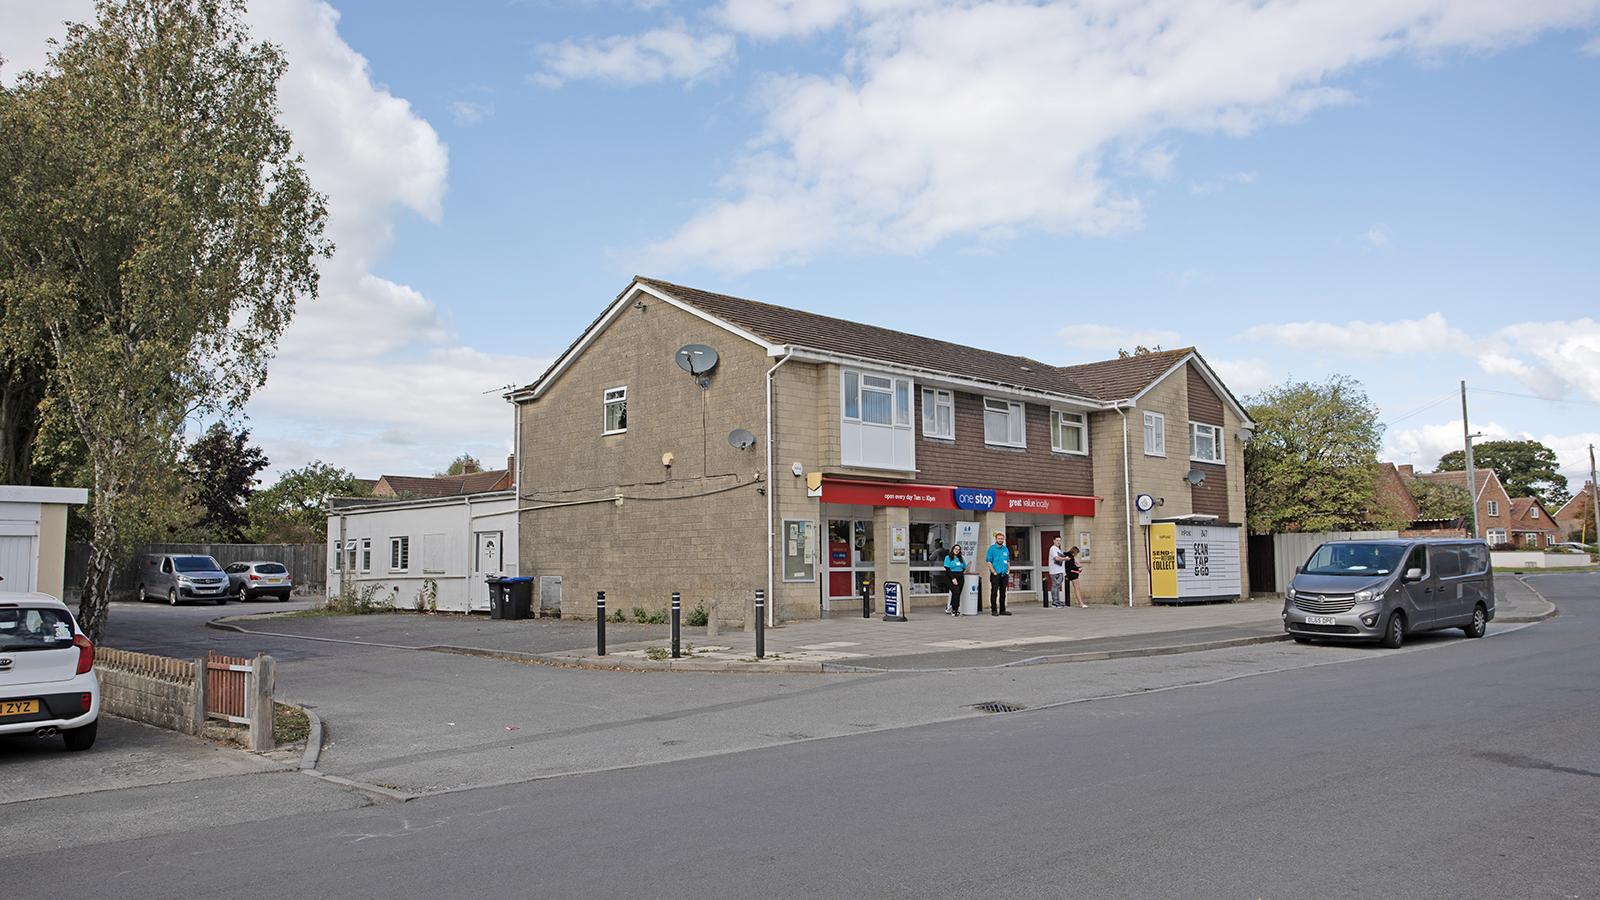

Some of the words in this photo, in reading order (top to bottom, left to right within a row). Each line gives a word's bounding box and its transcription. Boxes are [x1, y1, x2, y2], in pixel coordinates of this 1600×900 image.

[960, 494, 973, 504] one
[975, 492, 993, 507] stop
[1009, 499, 1022, 508] great
[1023, 500, 1035, 508] value
[1036, 500, 1049, 509] locally
[1194, 543, 1208, 555] SCAN
[1153, 561, 1175, 570] COLLECT
[1194, 556, 1209, 566] TAP
[6, 702, 30, 713] ZYZ
